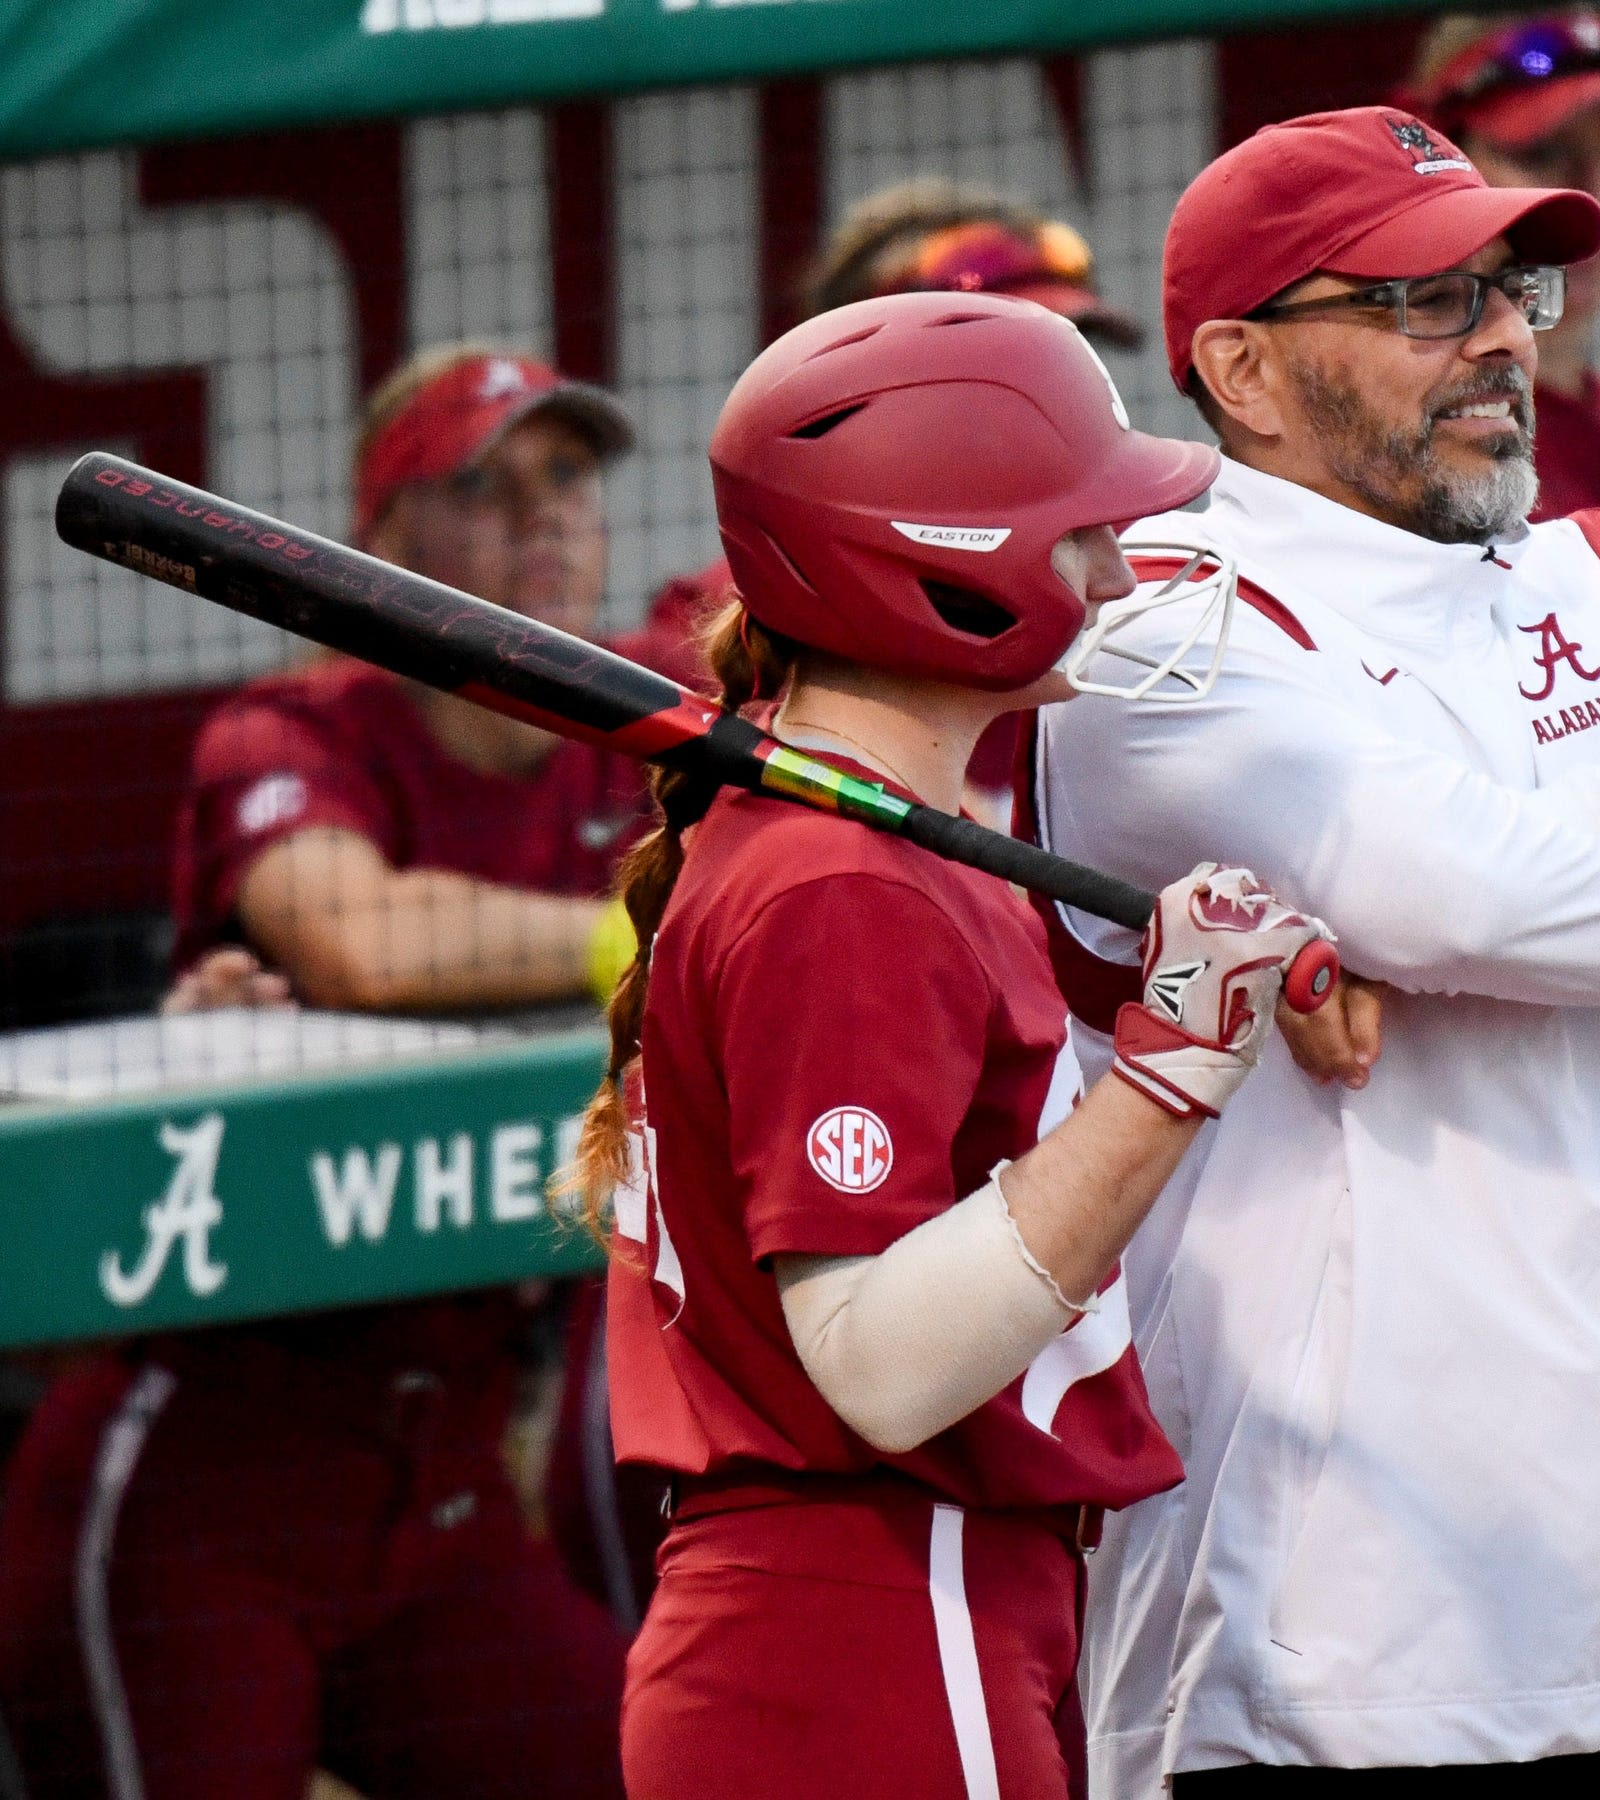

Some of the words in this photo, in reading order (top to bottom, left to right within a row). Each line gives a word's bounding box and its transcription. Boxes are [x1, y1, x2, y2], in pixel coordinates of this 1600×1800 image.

[95, 469, 314, 561] ADVANCED
[917, 529, 996, 543] EASTON
[814, 1111, 888, 1188] SEC
[101, 1113, 227, 1306] A
